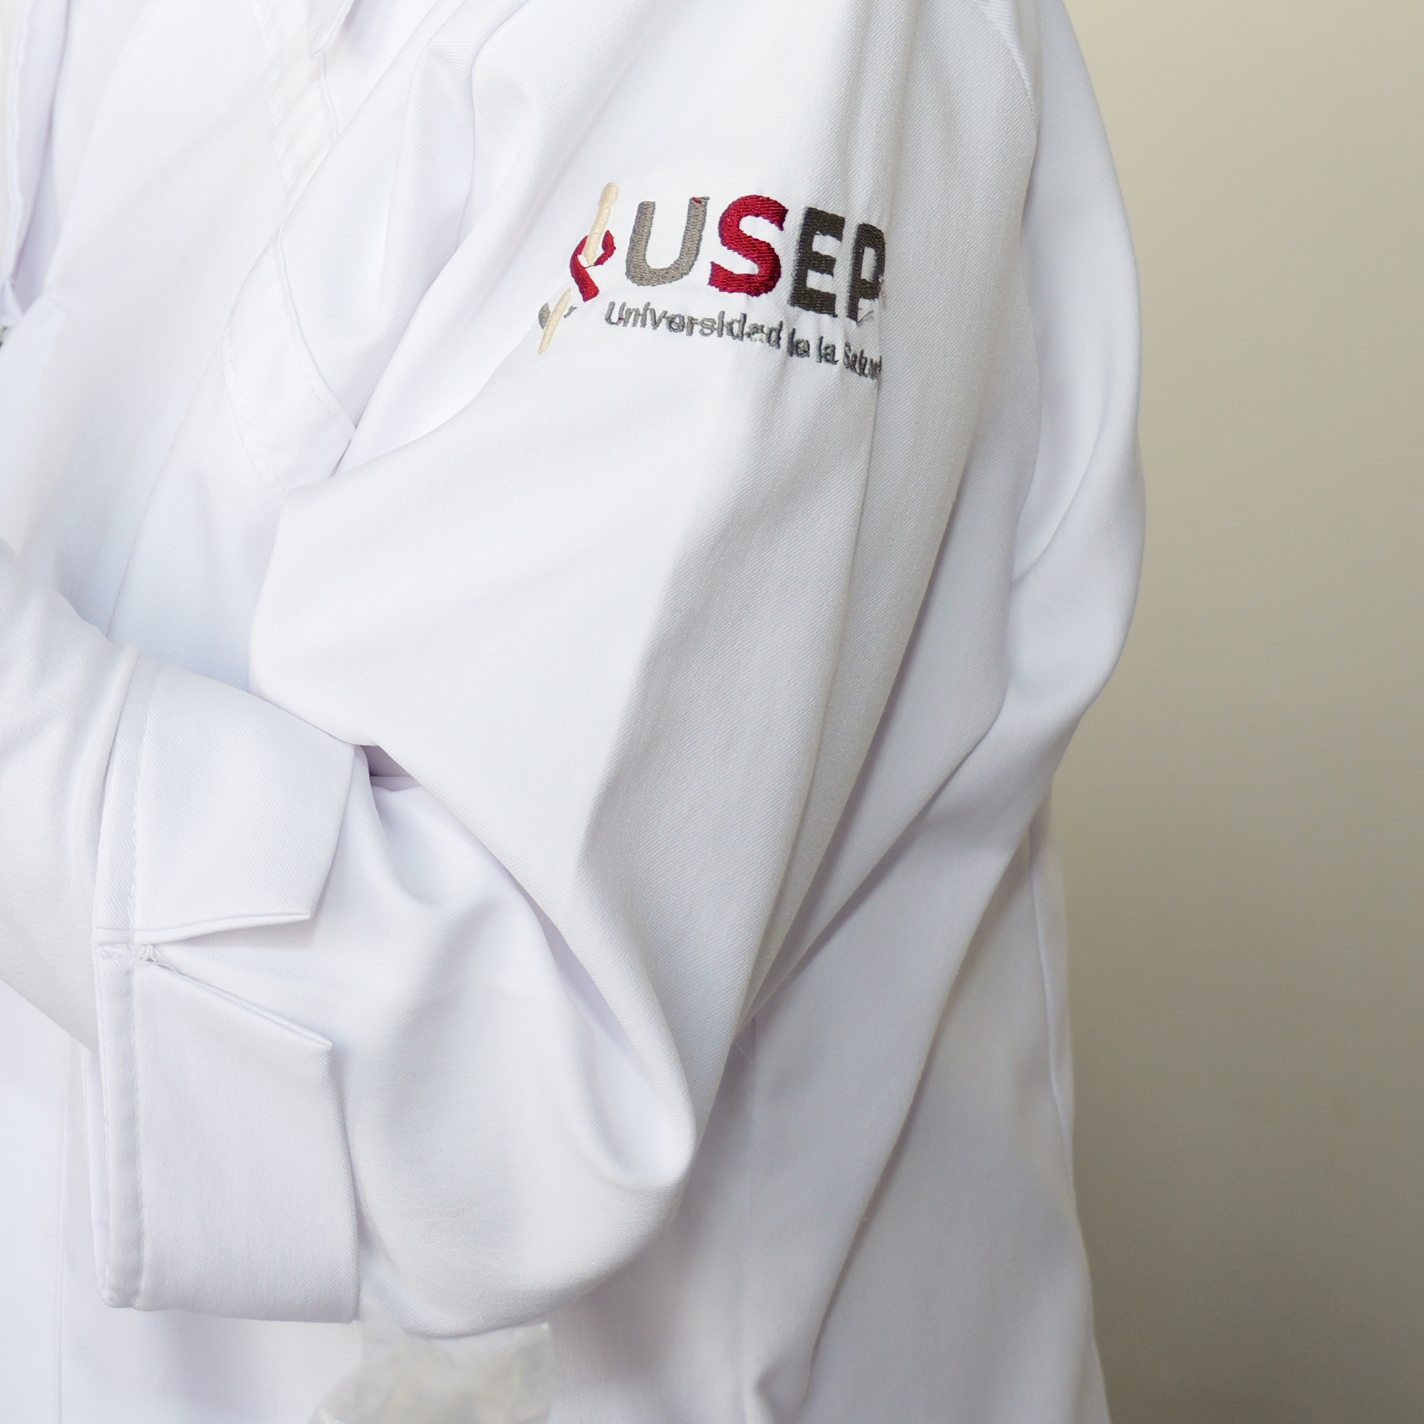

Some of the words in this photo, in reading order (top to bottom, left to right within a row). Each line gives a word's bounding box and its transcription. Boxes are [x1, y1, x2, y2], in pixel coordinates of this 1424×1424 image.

[625, 194, 887, 324] USEP
[604, 301, 784, 350] Universidad
[815, 335, 840, 366] la
